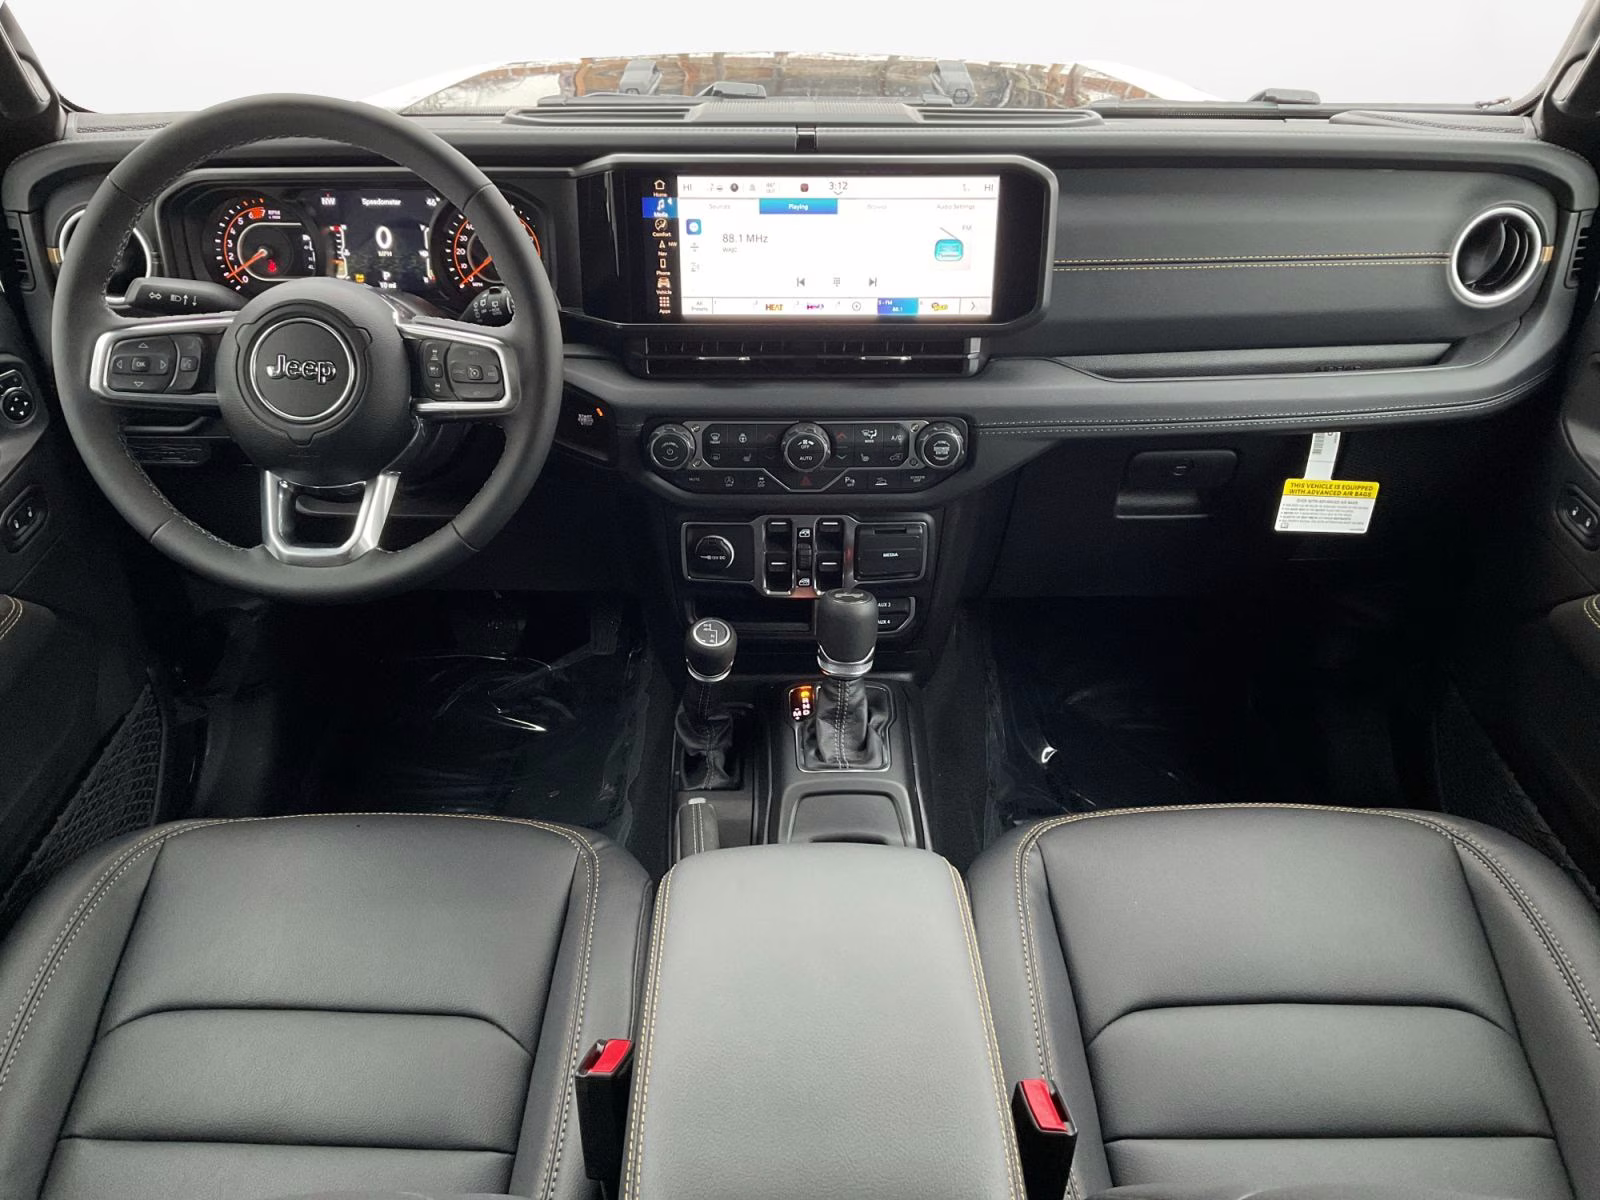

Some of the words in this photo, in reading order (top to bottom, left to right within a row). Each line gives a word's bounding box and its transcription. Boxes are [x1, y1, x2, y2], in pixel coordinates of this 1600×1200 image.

[829, 181, 848, 190] 3:12
[984, 184, 994, 192] HI
[361, 198, 401, 207] Speedometer
[230, 227, 236, 235] 4
[375, 226, 392, 249] 0
[722, 234, 743, 244] 88.1
[746, 234, 769, 244] MHz
[242, 275, 249, 283] 0
[382, 271, 391, 281] P
[266, 353, 336, 385] Jeep
